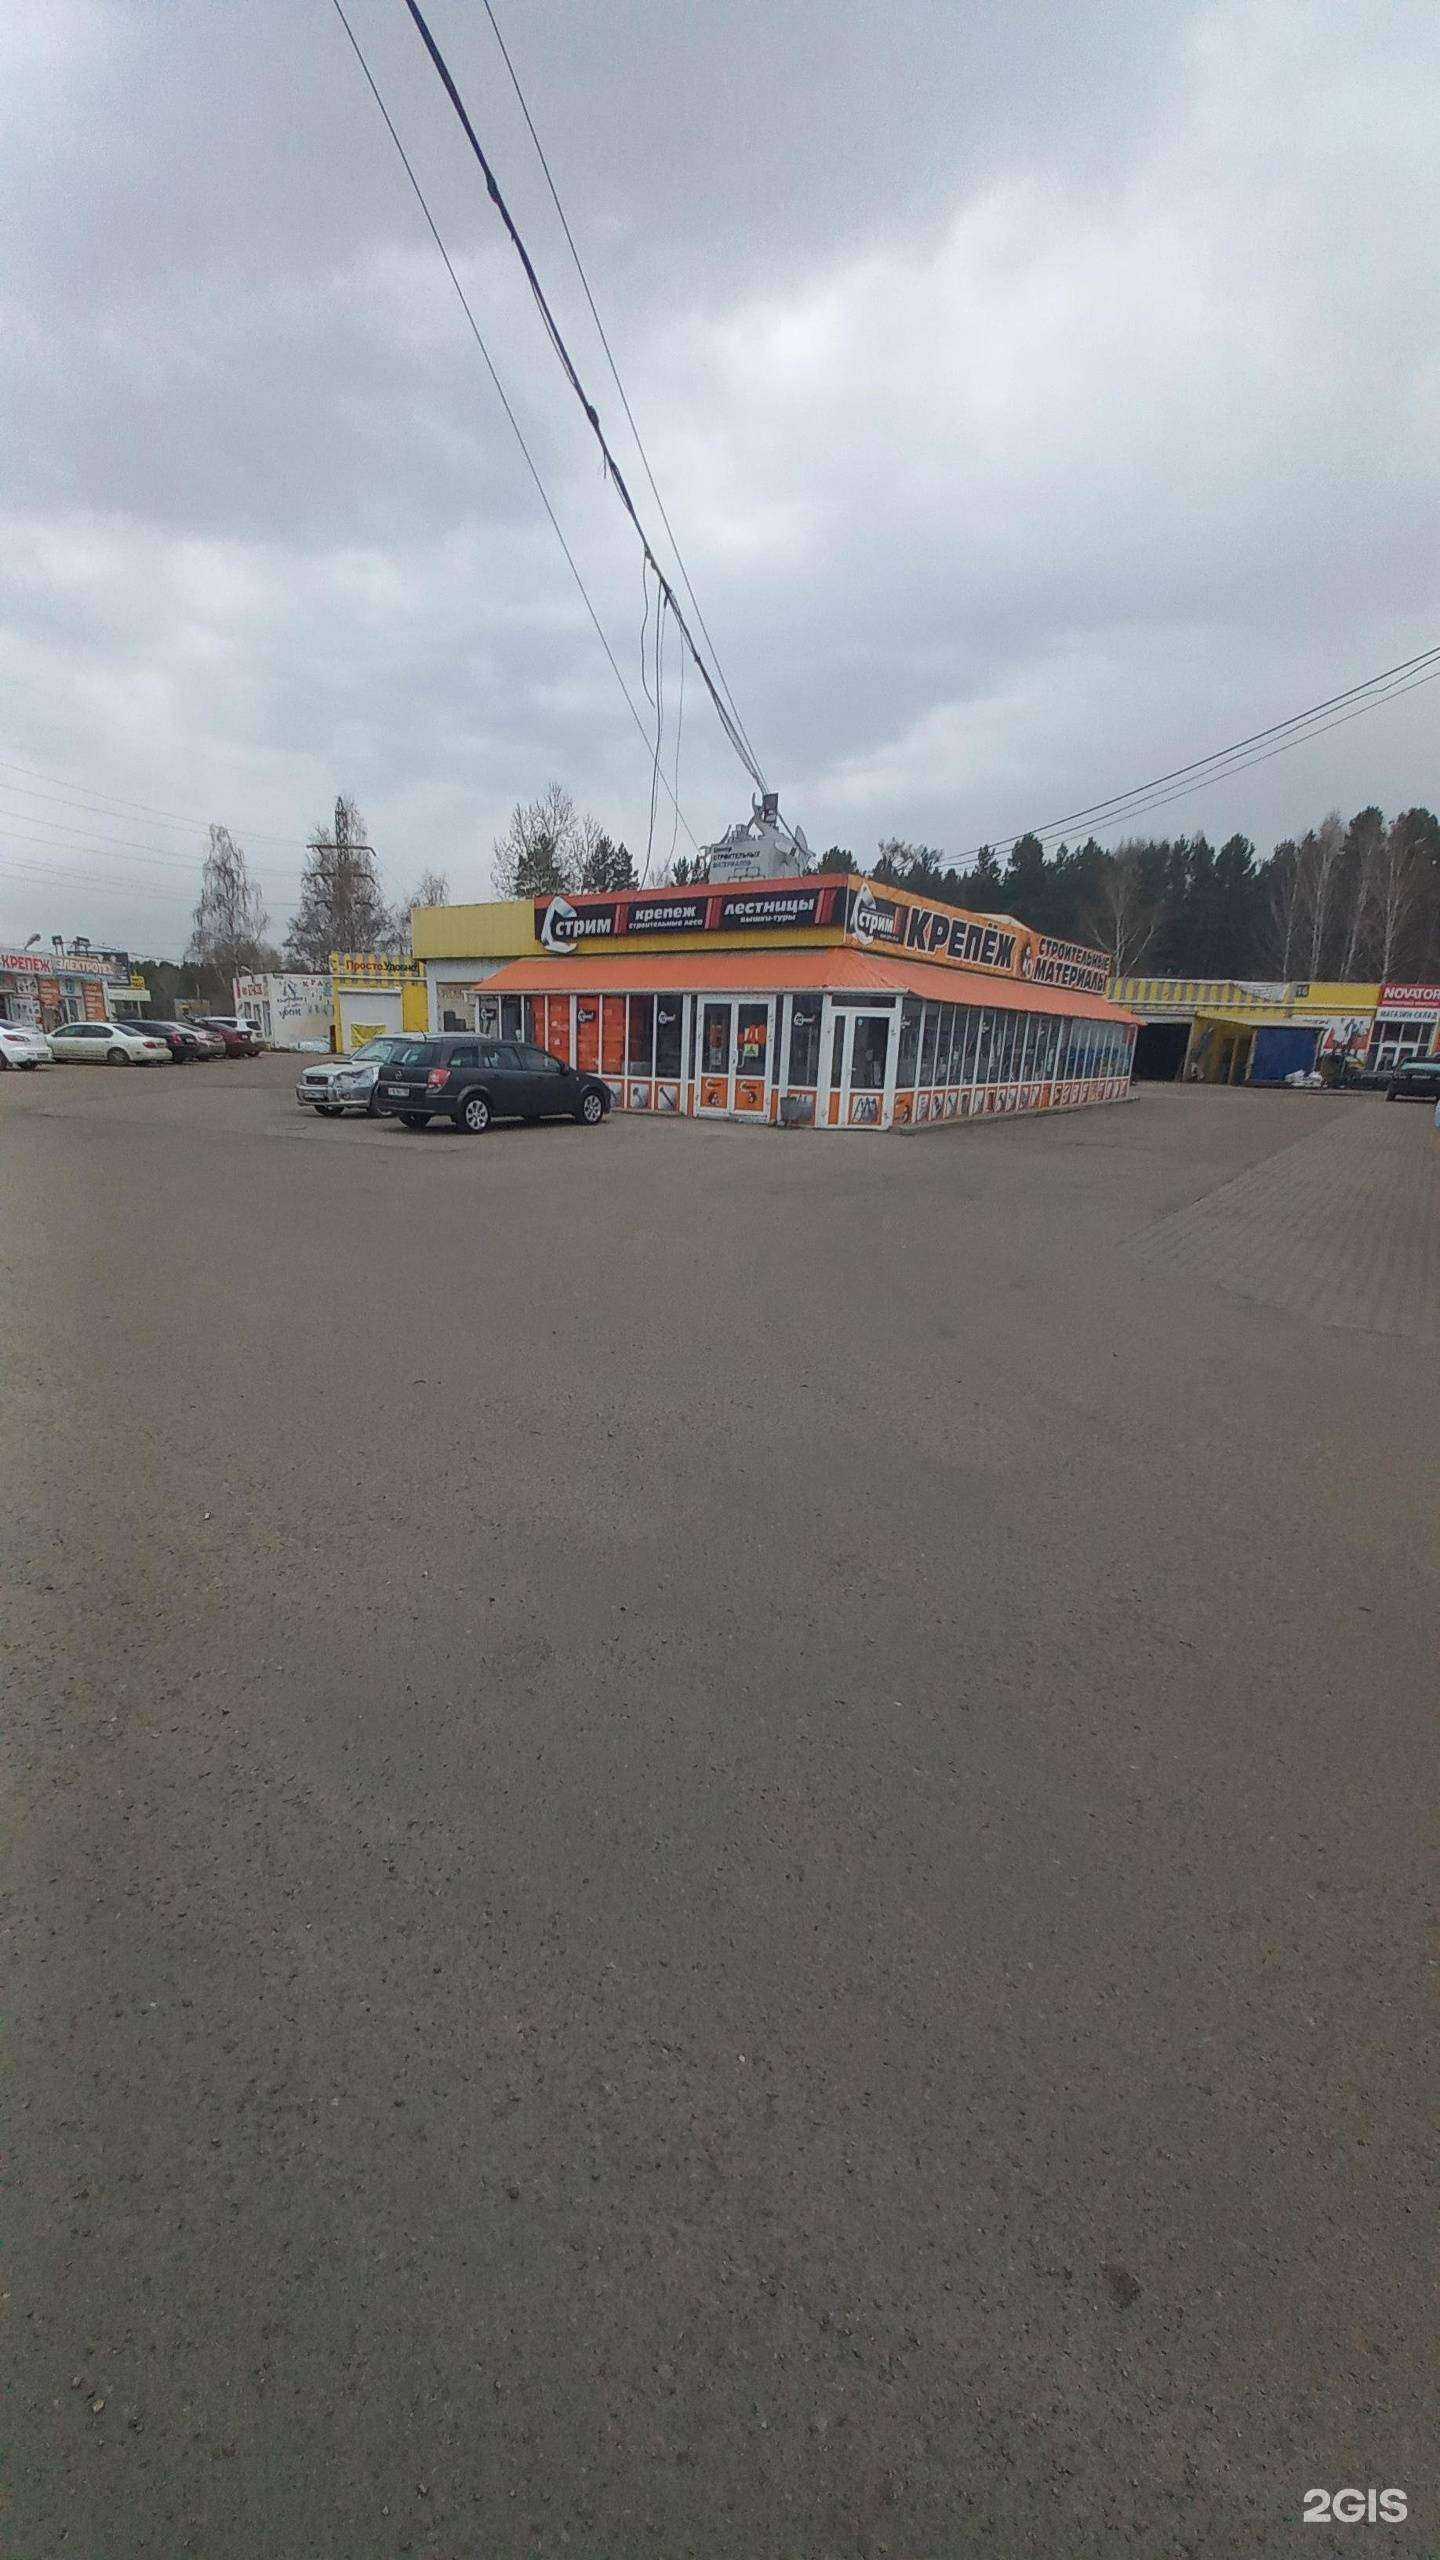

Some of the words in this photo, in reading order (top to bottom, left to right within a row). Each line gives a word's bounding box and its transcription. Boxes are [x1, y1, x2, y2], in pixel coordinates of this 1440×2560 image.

[635, 906, 696, 921] крепеж
[724, 898, 815, 915] лестницы
[906, 906, 1016, 970] КРЕПЁЖ
[1, 954, 52, 972] КРЕПЕЖ
[346, 959, 382, 972] Просто
[1033, 956, 1107, 994] МАТЕРИАЛЫ
[1383, 986, 1440, 1000] NOVATOR
